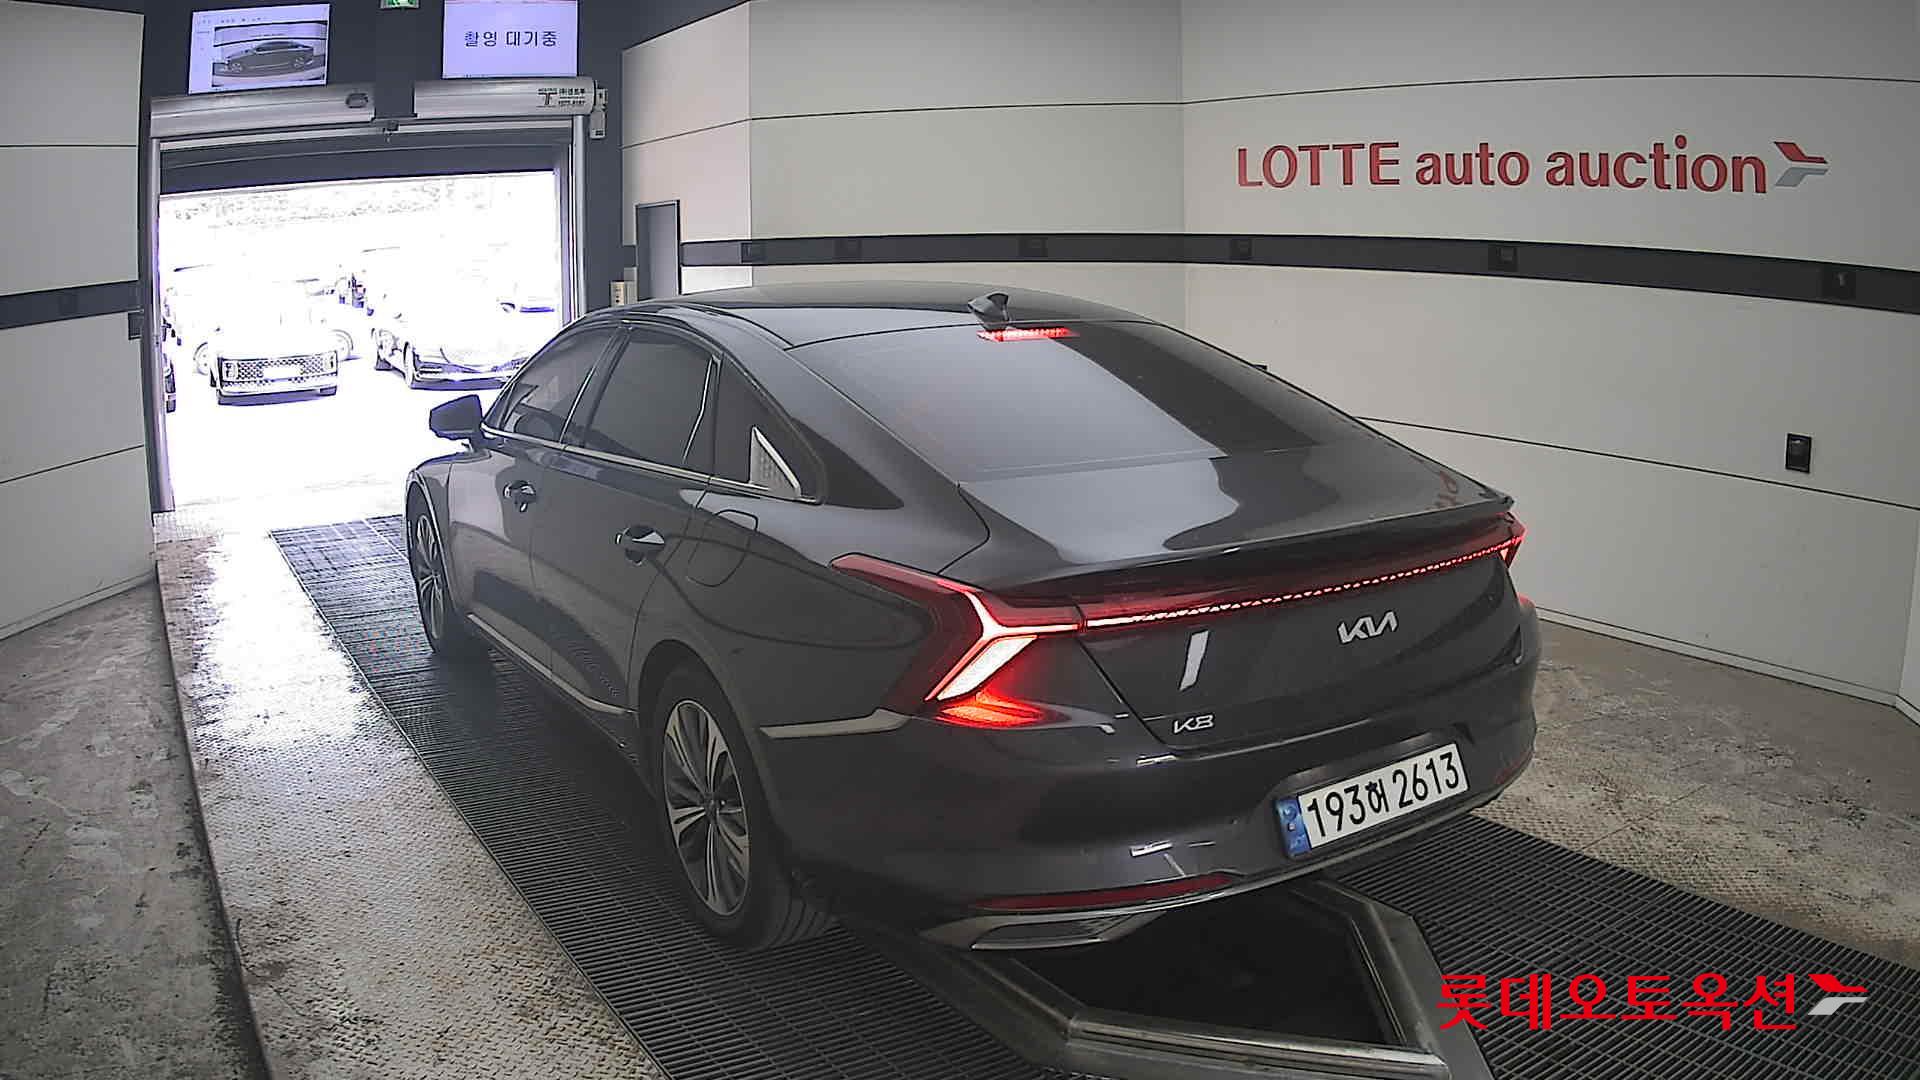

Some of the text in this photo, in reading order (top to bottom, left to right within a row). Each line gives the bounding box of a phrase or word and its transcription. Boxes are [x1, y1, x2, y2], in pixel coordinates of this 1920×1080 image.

[465, 31, 557, 47] 촬영 대기중
[1237, 134, 1768, 195] LOTTE auto auction
[1337, 611, 1398, 644] KIA
[1173, 713, 1215, 735] K8
[1307, 751, 1459, 837] 193허 2613
